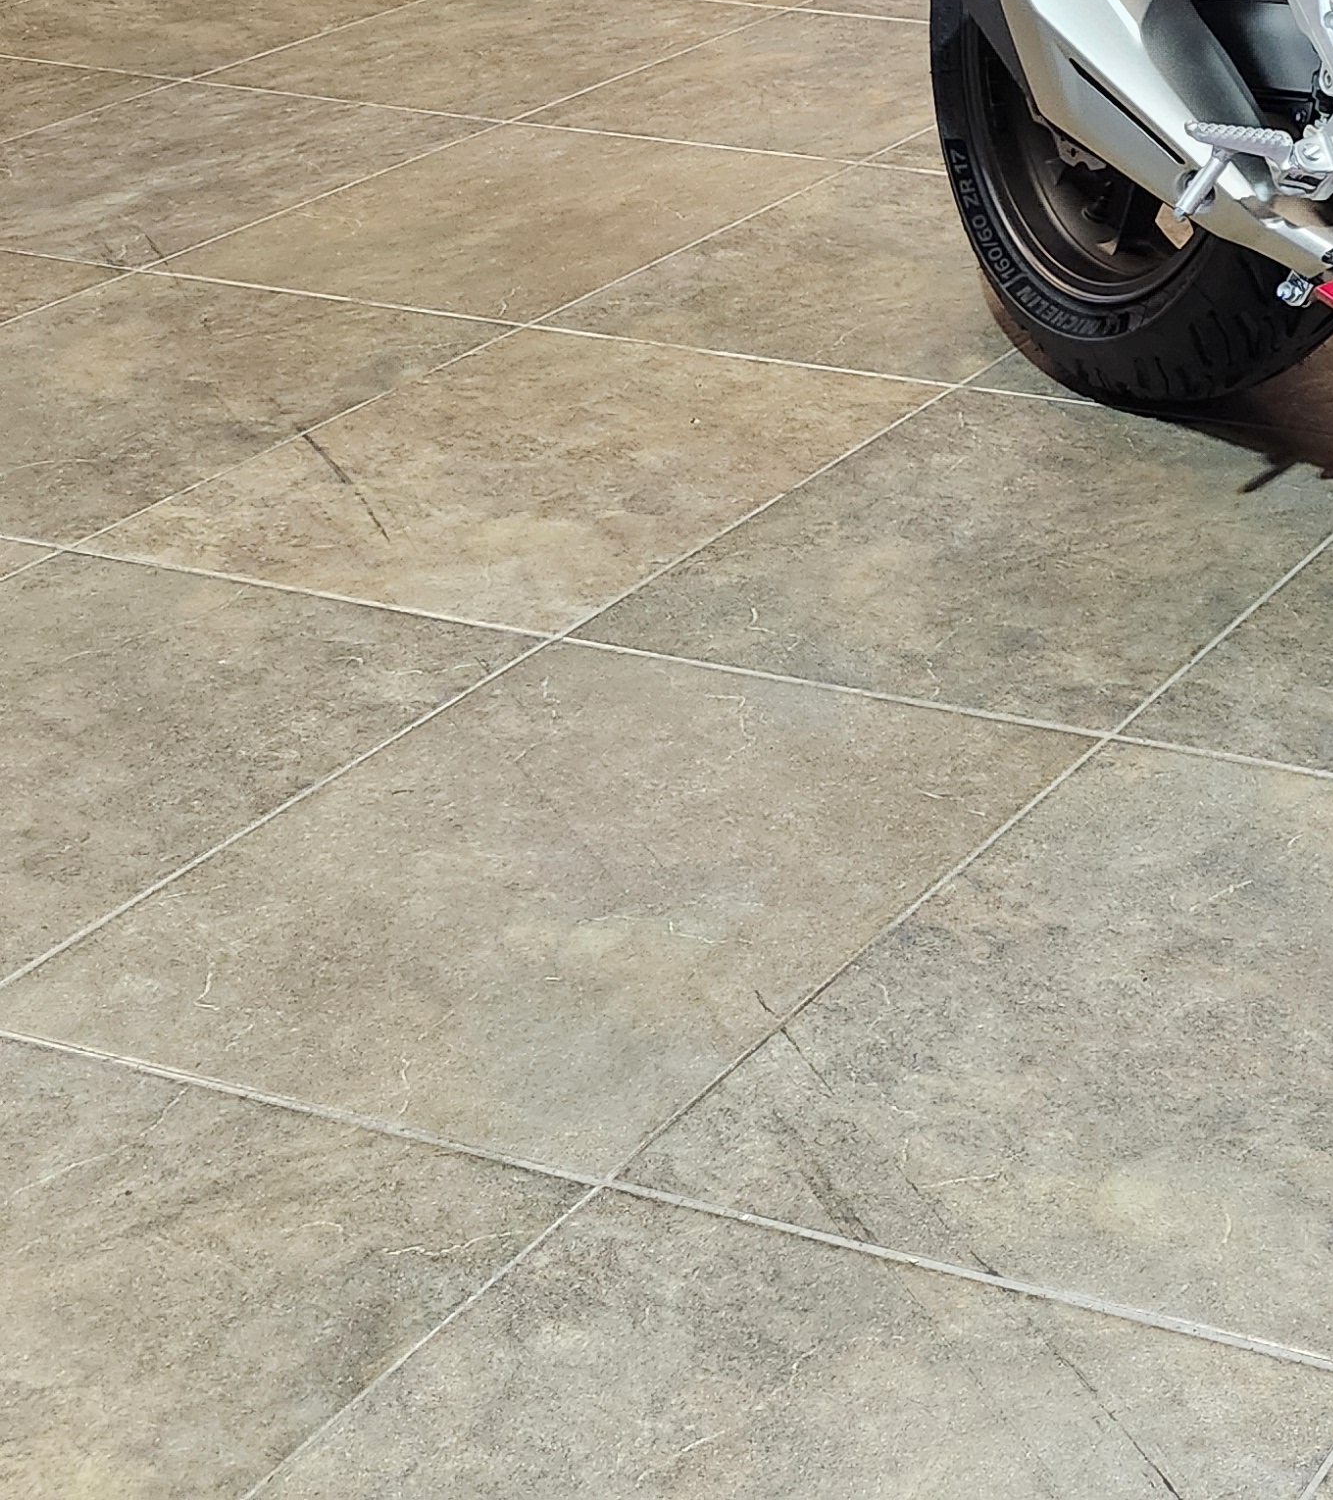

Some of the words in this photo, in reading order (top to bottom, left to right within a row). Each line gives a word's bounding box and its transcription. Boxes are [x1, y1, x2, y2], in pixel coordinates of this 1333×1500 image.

[951, 149, 967, 175] 17
[960, 179, 982, 208] ZR
[971, 214, 1019, 280] 160/60
